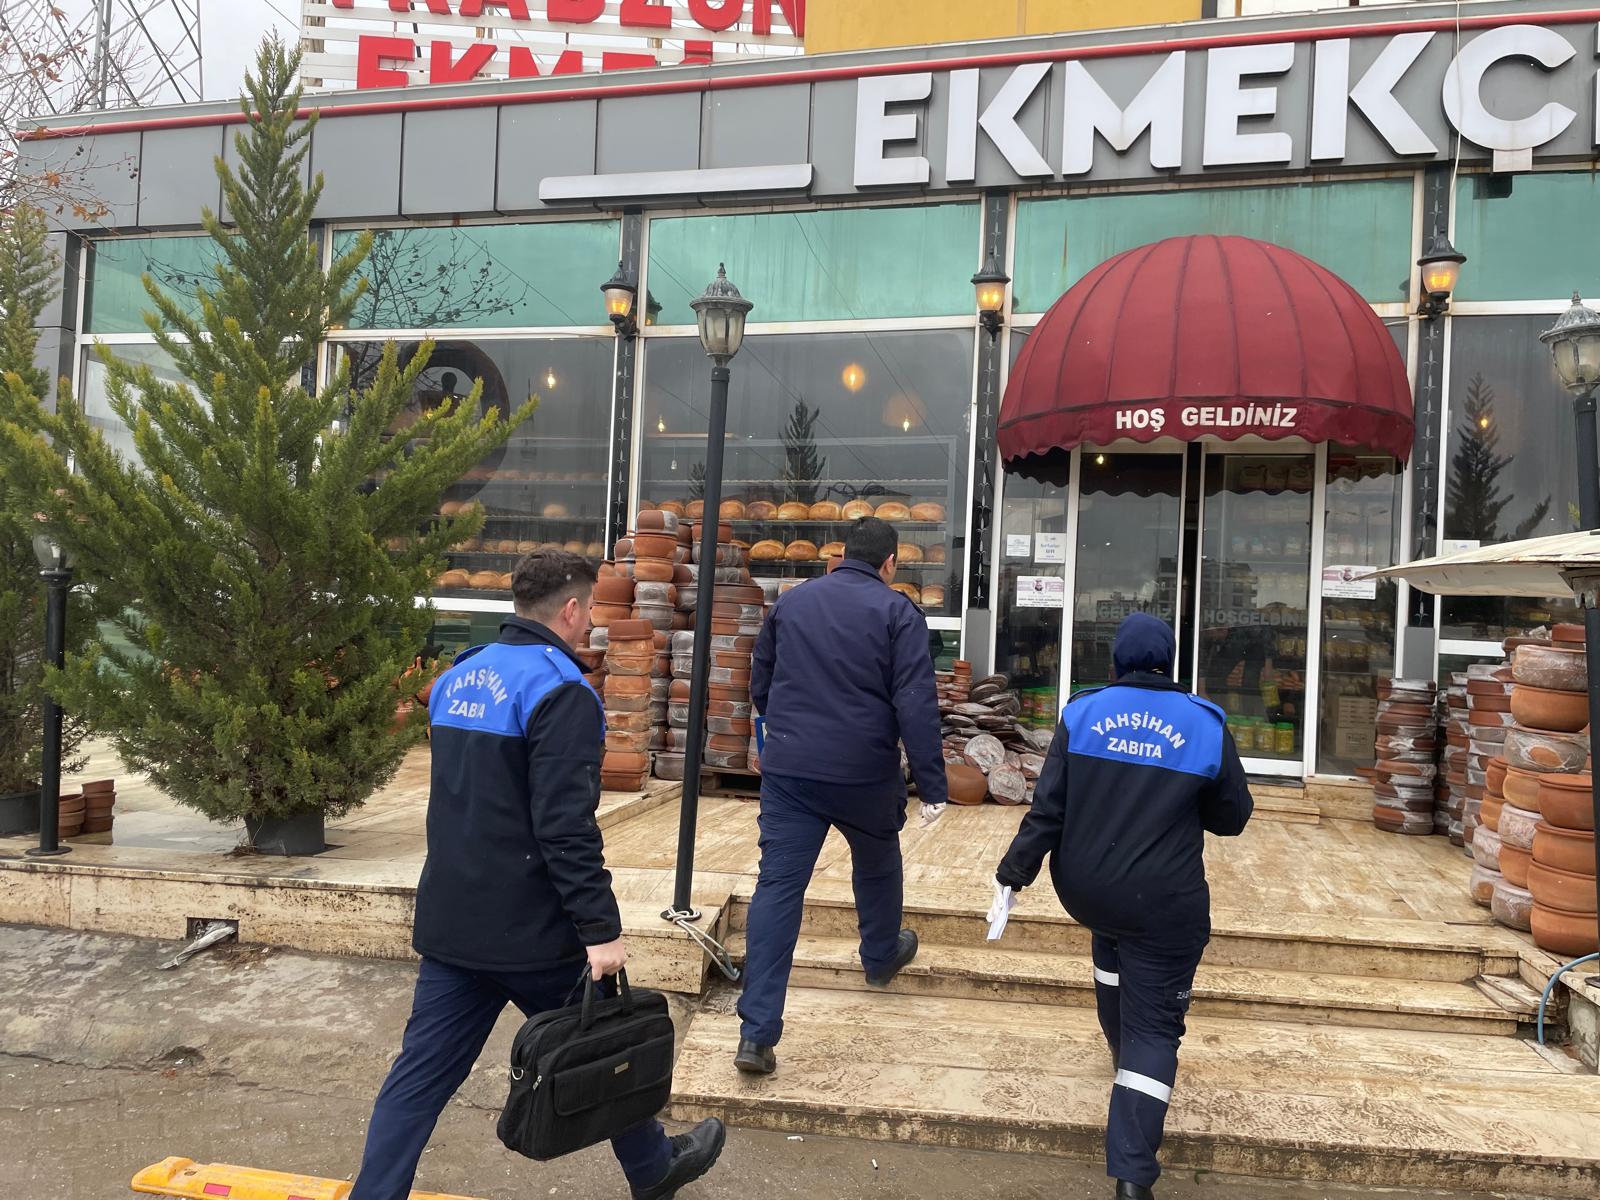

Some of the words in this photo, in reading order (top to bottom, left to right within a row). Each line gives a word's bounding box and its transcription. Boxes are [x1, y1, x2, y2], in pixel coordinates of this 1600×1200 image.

[854, 21, 1600, 187] EKMEKÇ
[1116, 408, 1165, 432] HOŞ
[1181, 403, 1297, 427] GELDİNİZ
[1091, 711, 1186, 749] YAHŞİHAN
[1107, 737, 1162, 758] ZABITA
